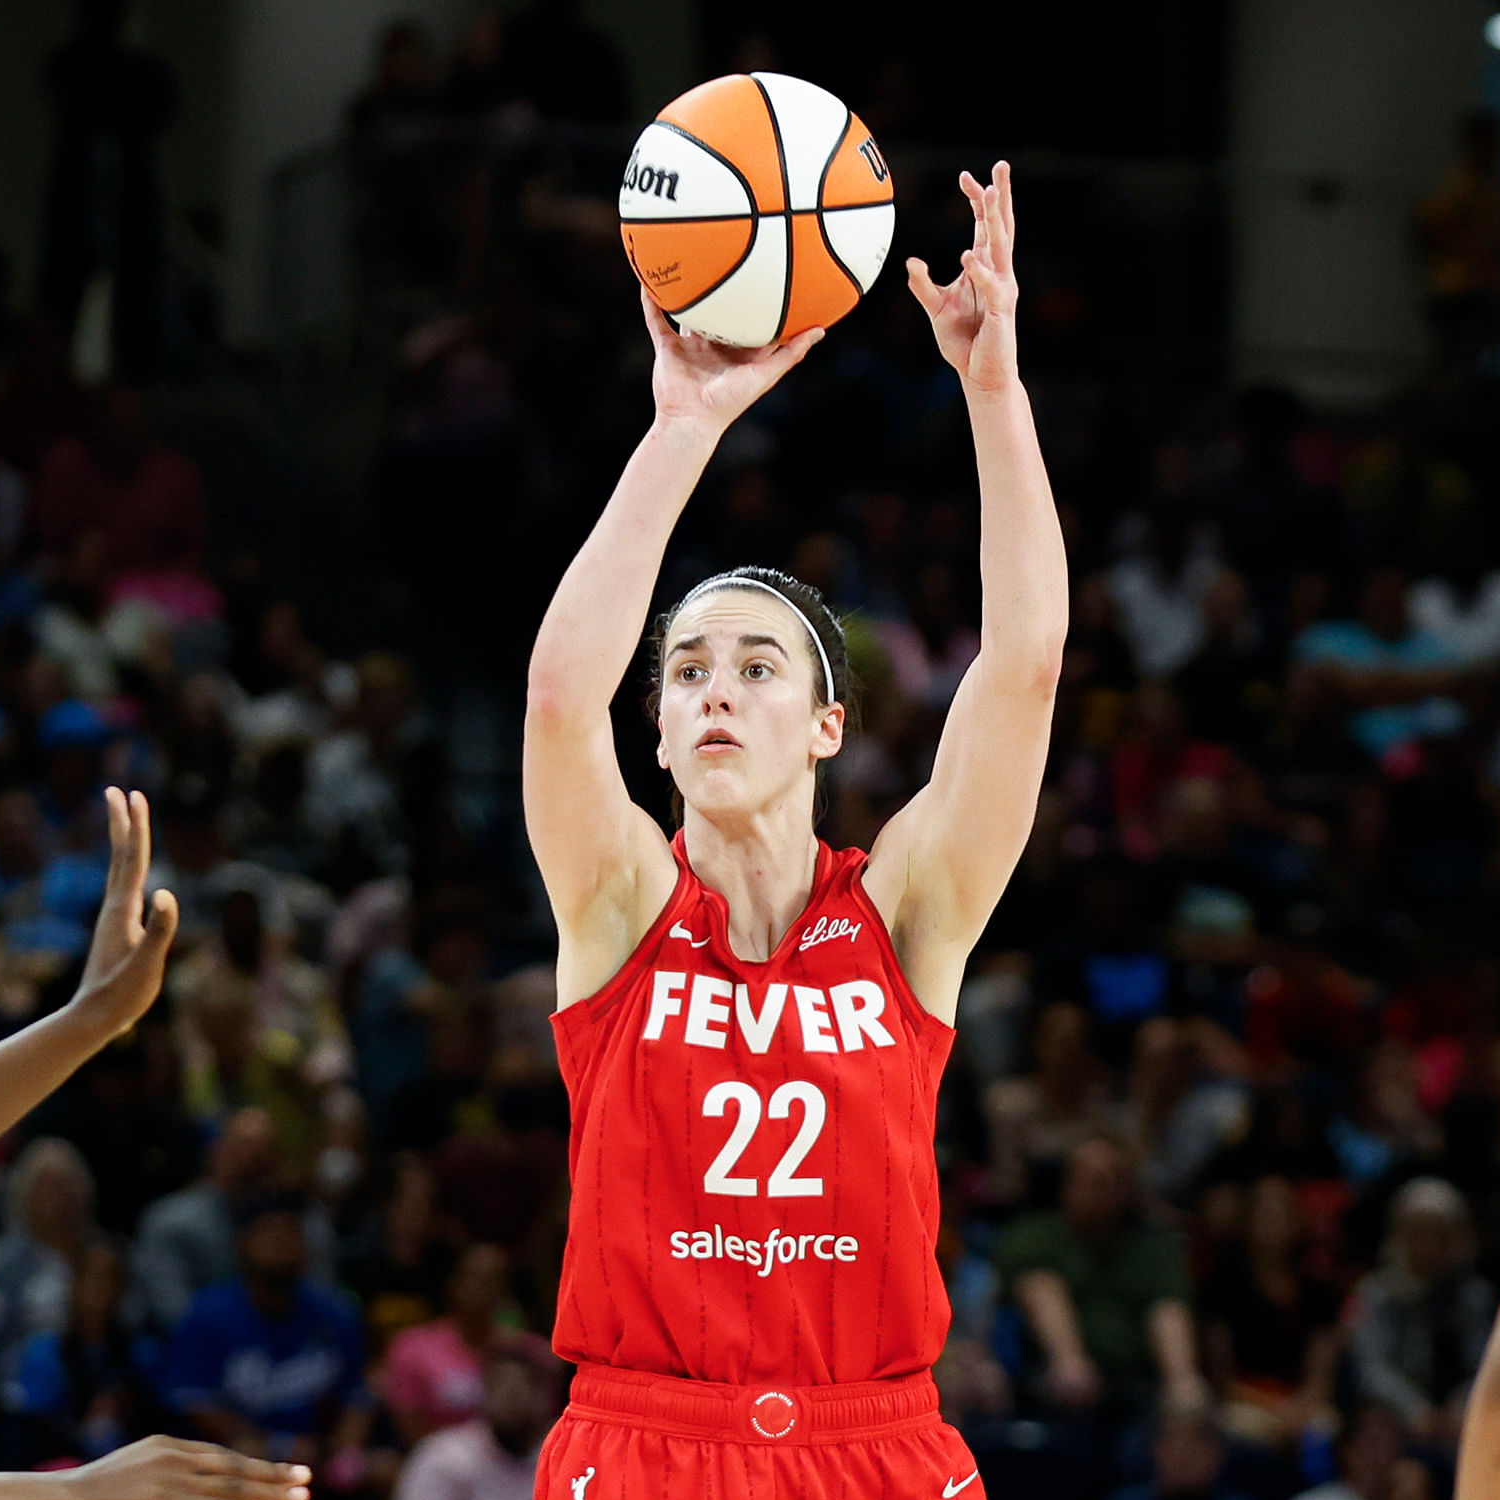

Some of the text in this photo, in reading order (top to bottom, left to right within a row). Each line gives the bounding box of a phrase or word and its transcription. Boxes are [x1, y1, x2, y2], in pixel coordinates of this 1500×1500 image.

[799, 916, 861, 951] Lilly
[642, 971, 895, 1054] FEVER
[702, 1080, 826, 1198] 22
[670, 1224, 859, 1277] salesforce
